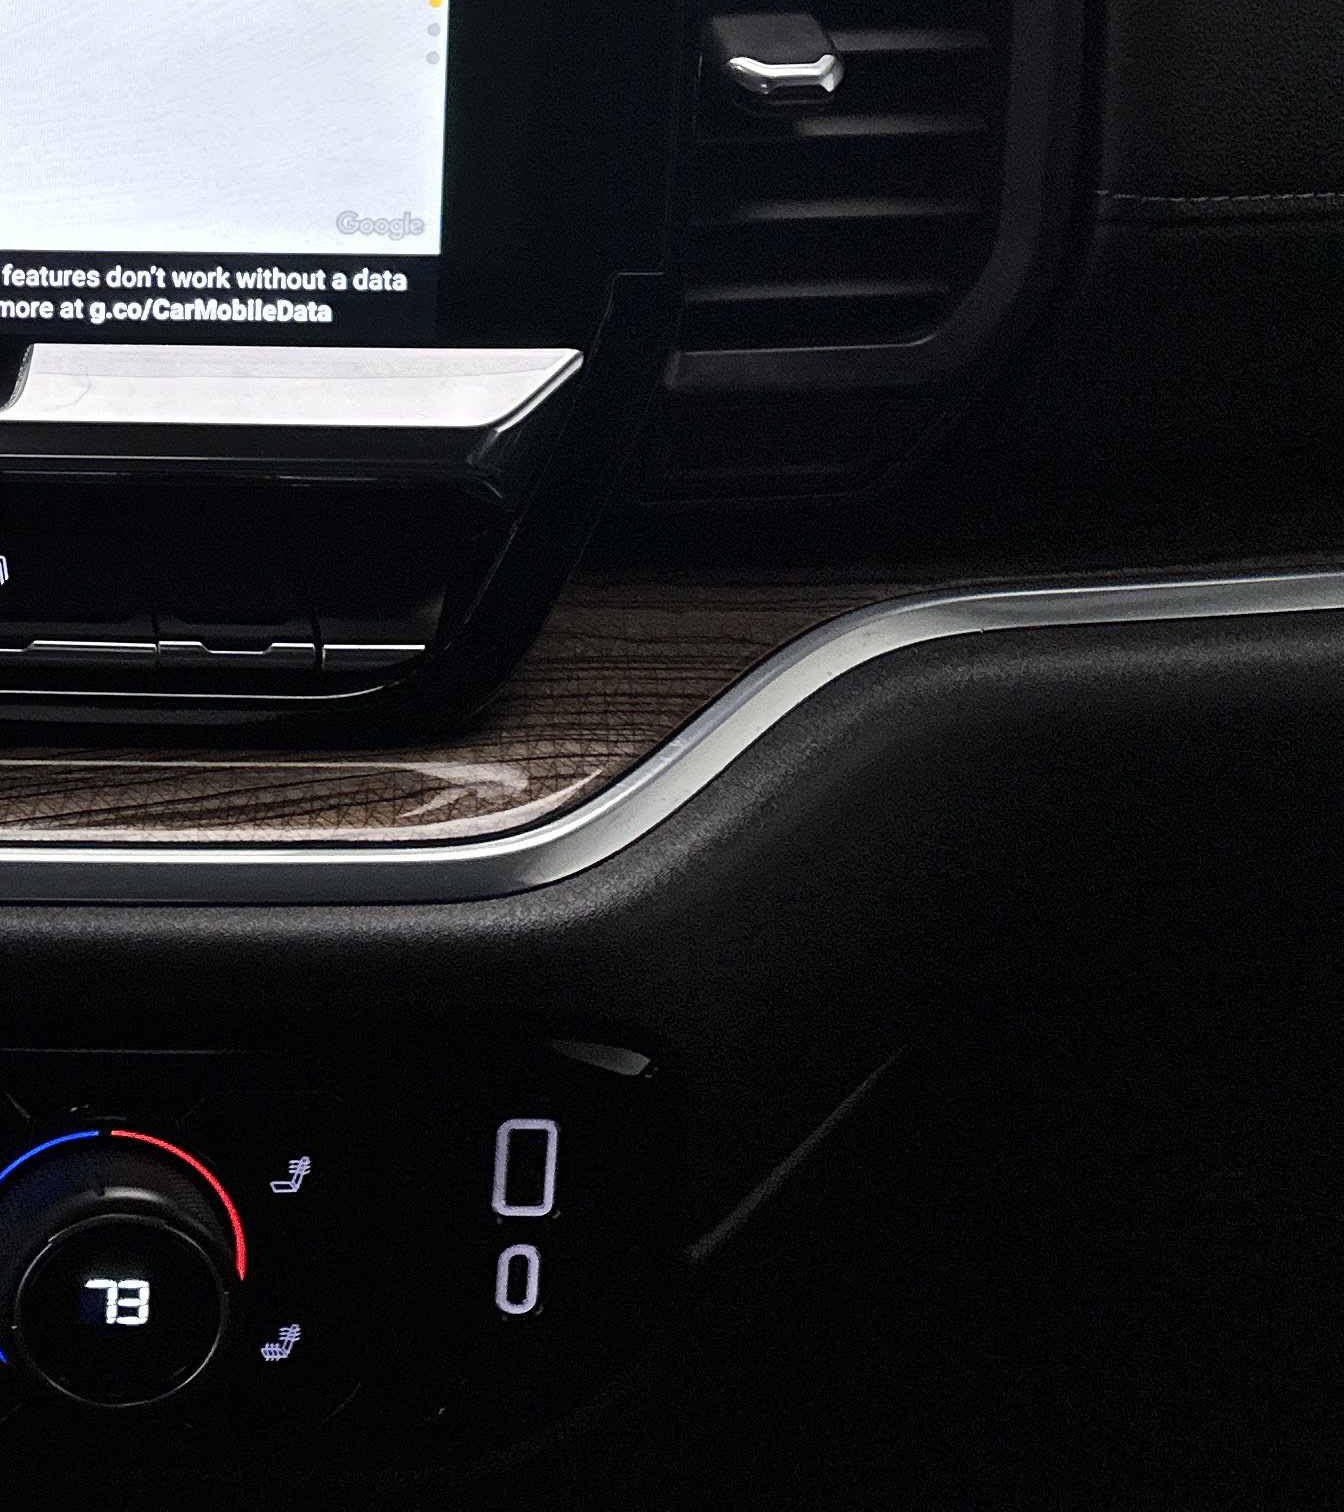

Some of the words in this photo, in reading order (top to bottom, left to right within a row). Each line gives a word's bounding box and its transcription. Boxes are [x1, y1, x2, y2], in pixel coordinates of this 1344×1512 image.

[335, 210, 425, 241] Google
[1, 263, 100, 288] features
[105, 264, 166, 289] don't
[171, 265, 231, 290] work
[235, 266, 327, 291] without
[331, 272, 348, 291] a
[352, 267, 408, 292] data
[59, 298, 84, 320] at
[88, 296, 333, 326] g.co/CarMobileData
[84, 1277, 151, 1326] 73
